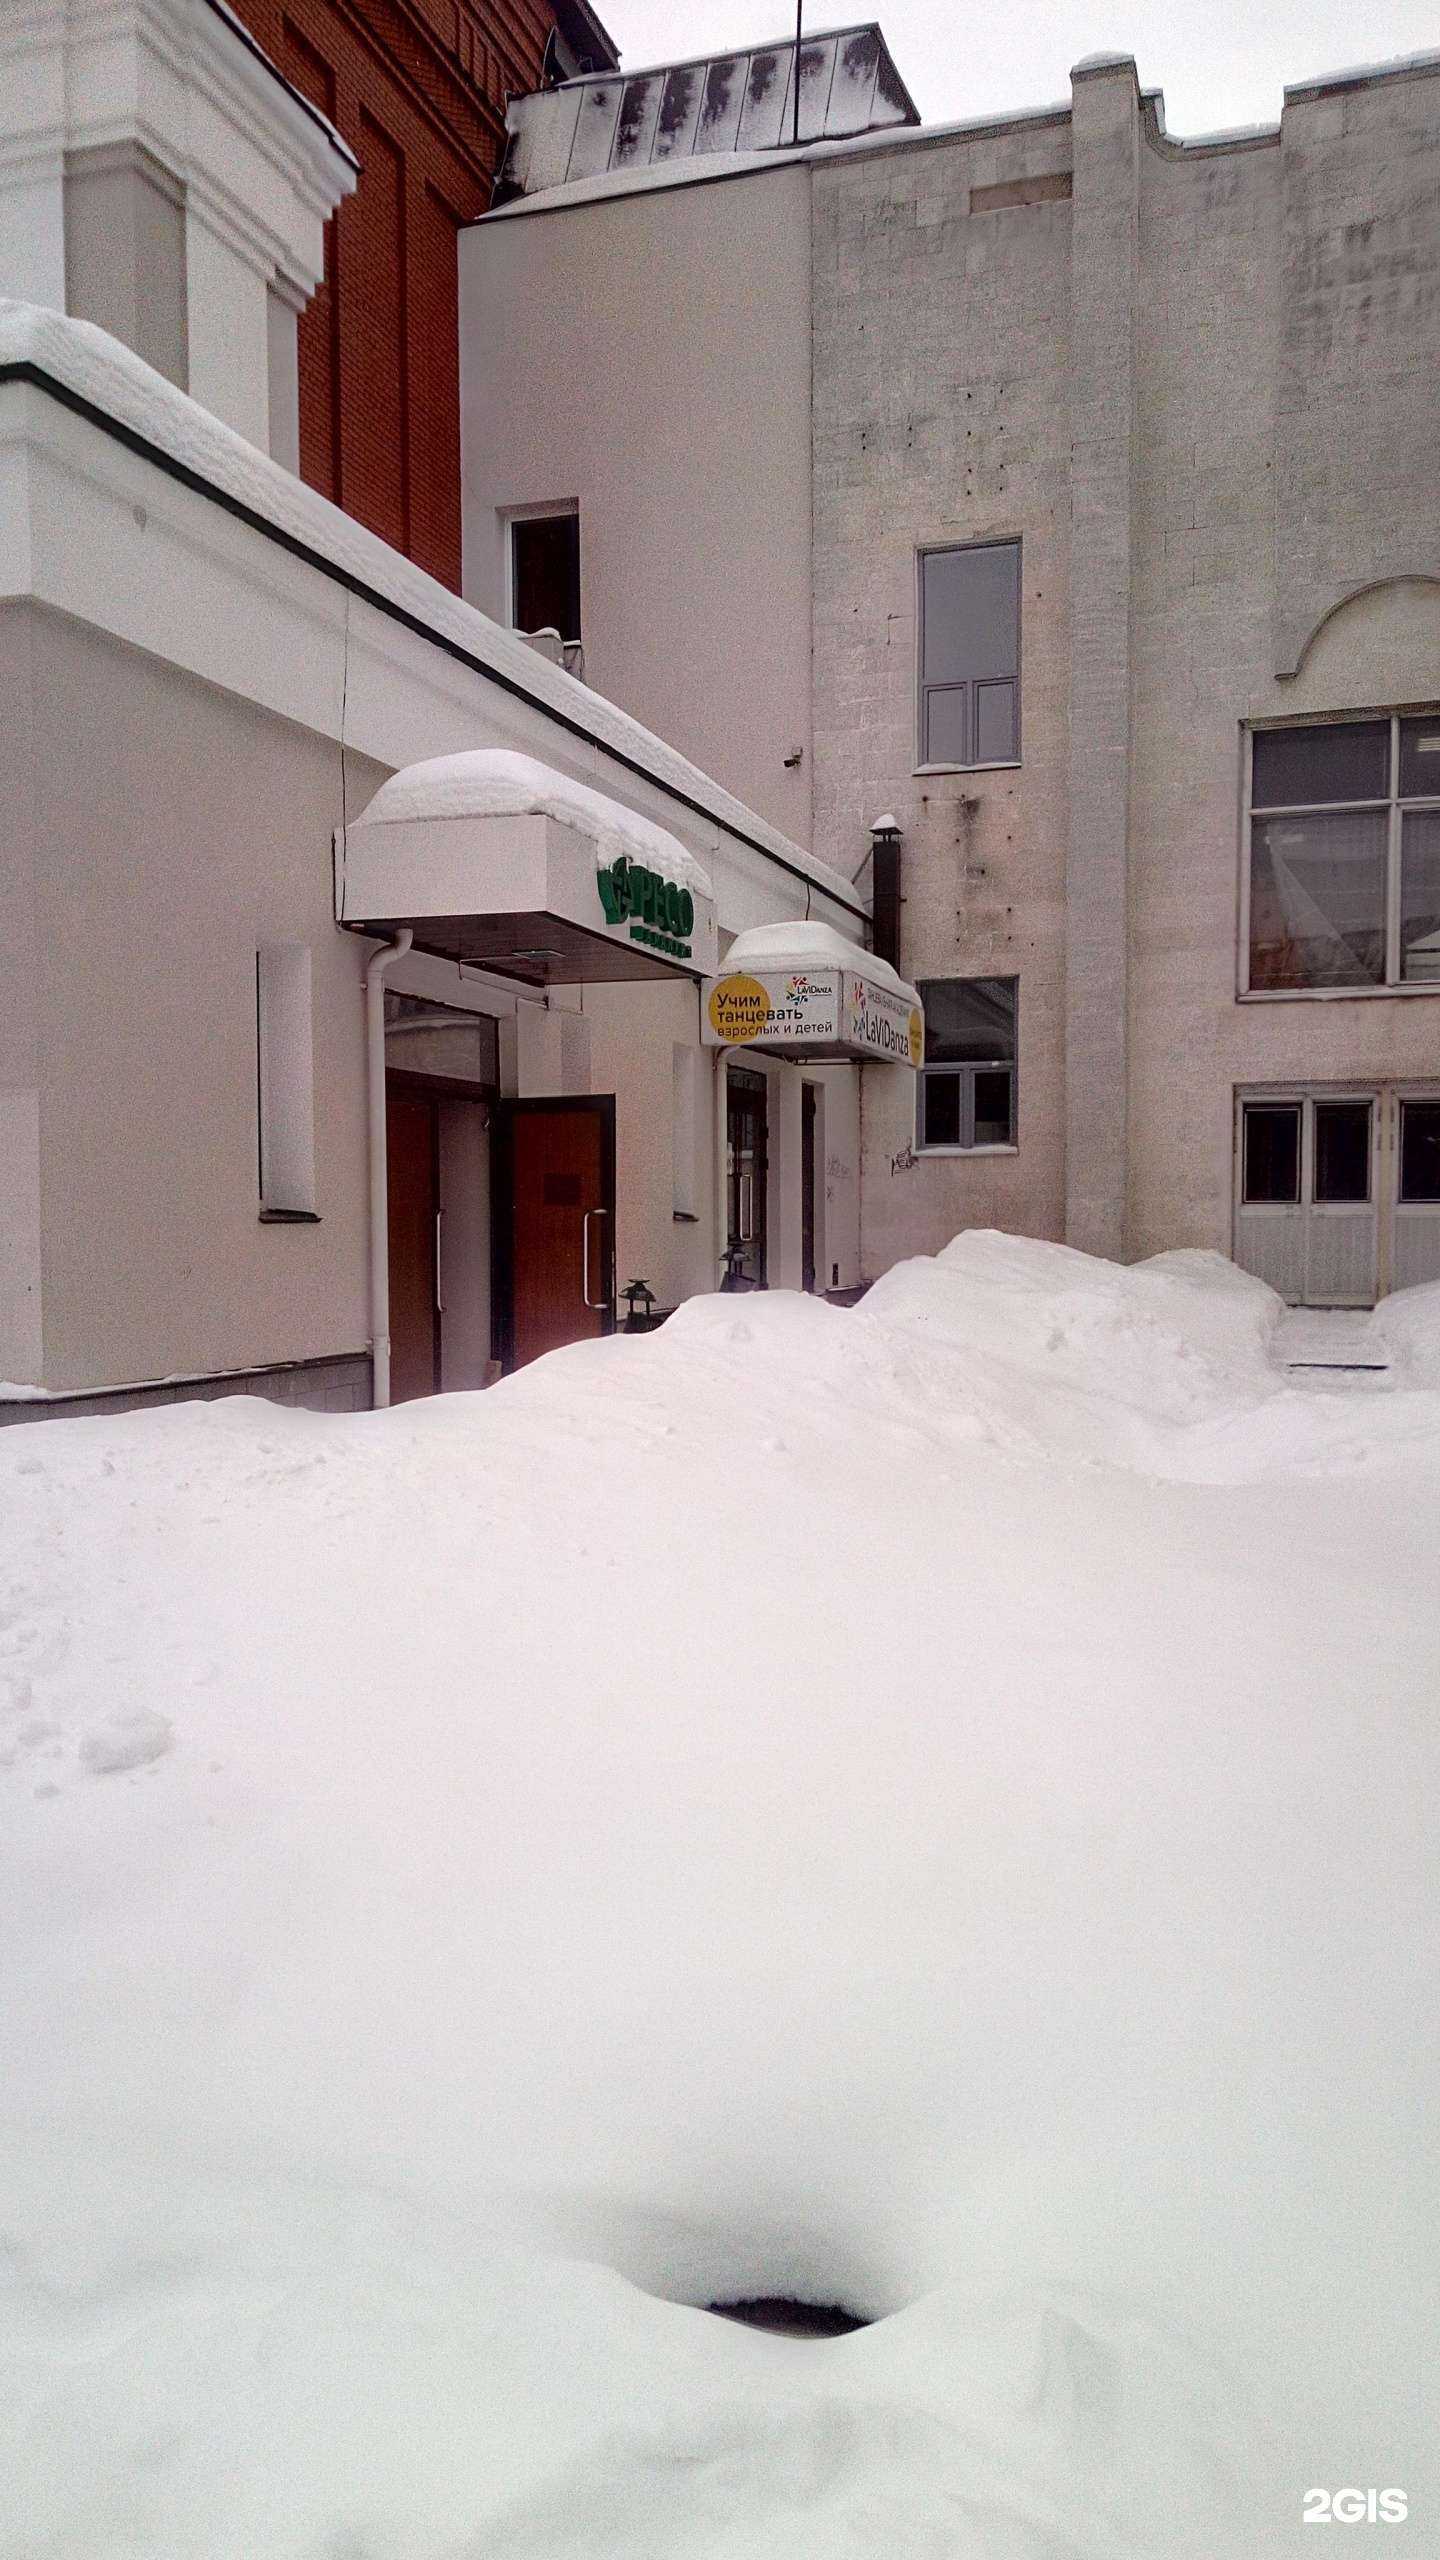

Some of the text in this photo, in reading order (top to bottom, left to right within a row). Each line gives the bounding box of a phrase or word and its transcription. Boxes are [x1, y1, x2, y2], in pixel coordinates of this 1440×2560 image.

[717, 993, 760, 1009] Учим
[717, 1008, 804, 1024] танцевать
[717, 1021, 832, 1038] взрослых и детей
[865, 1009, 909, 1057] LaViDanza
